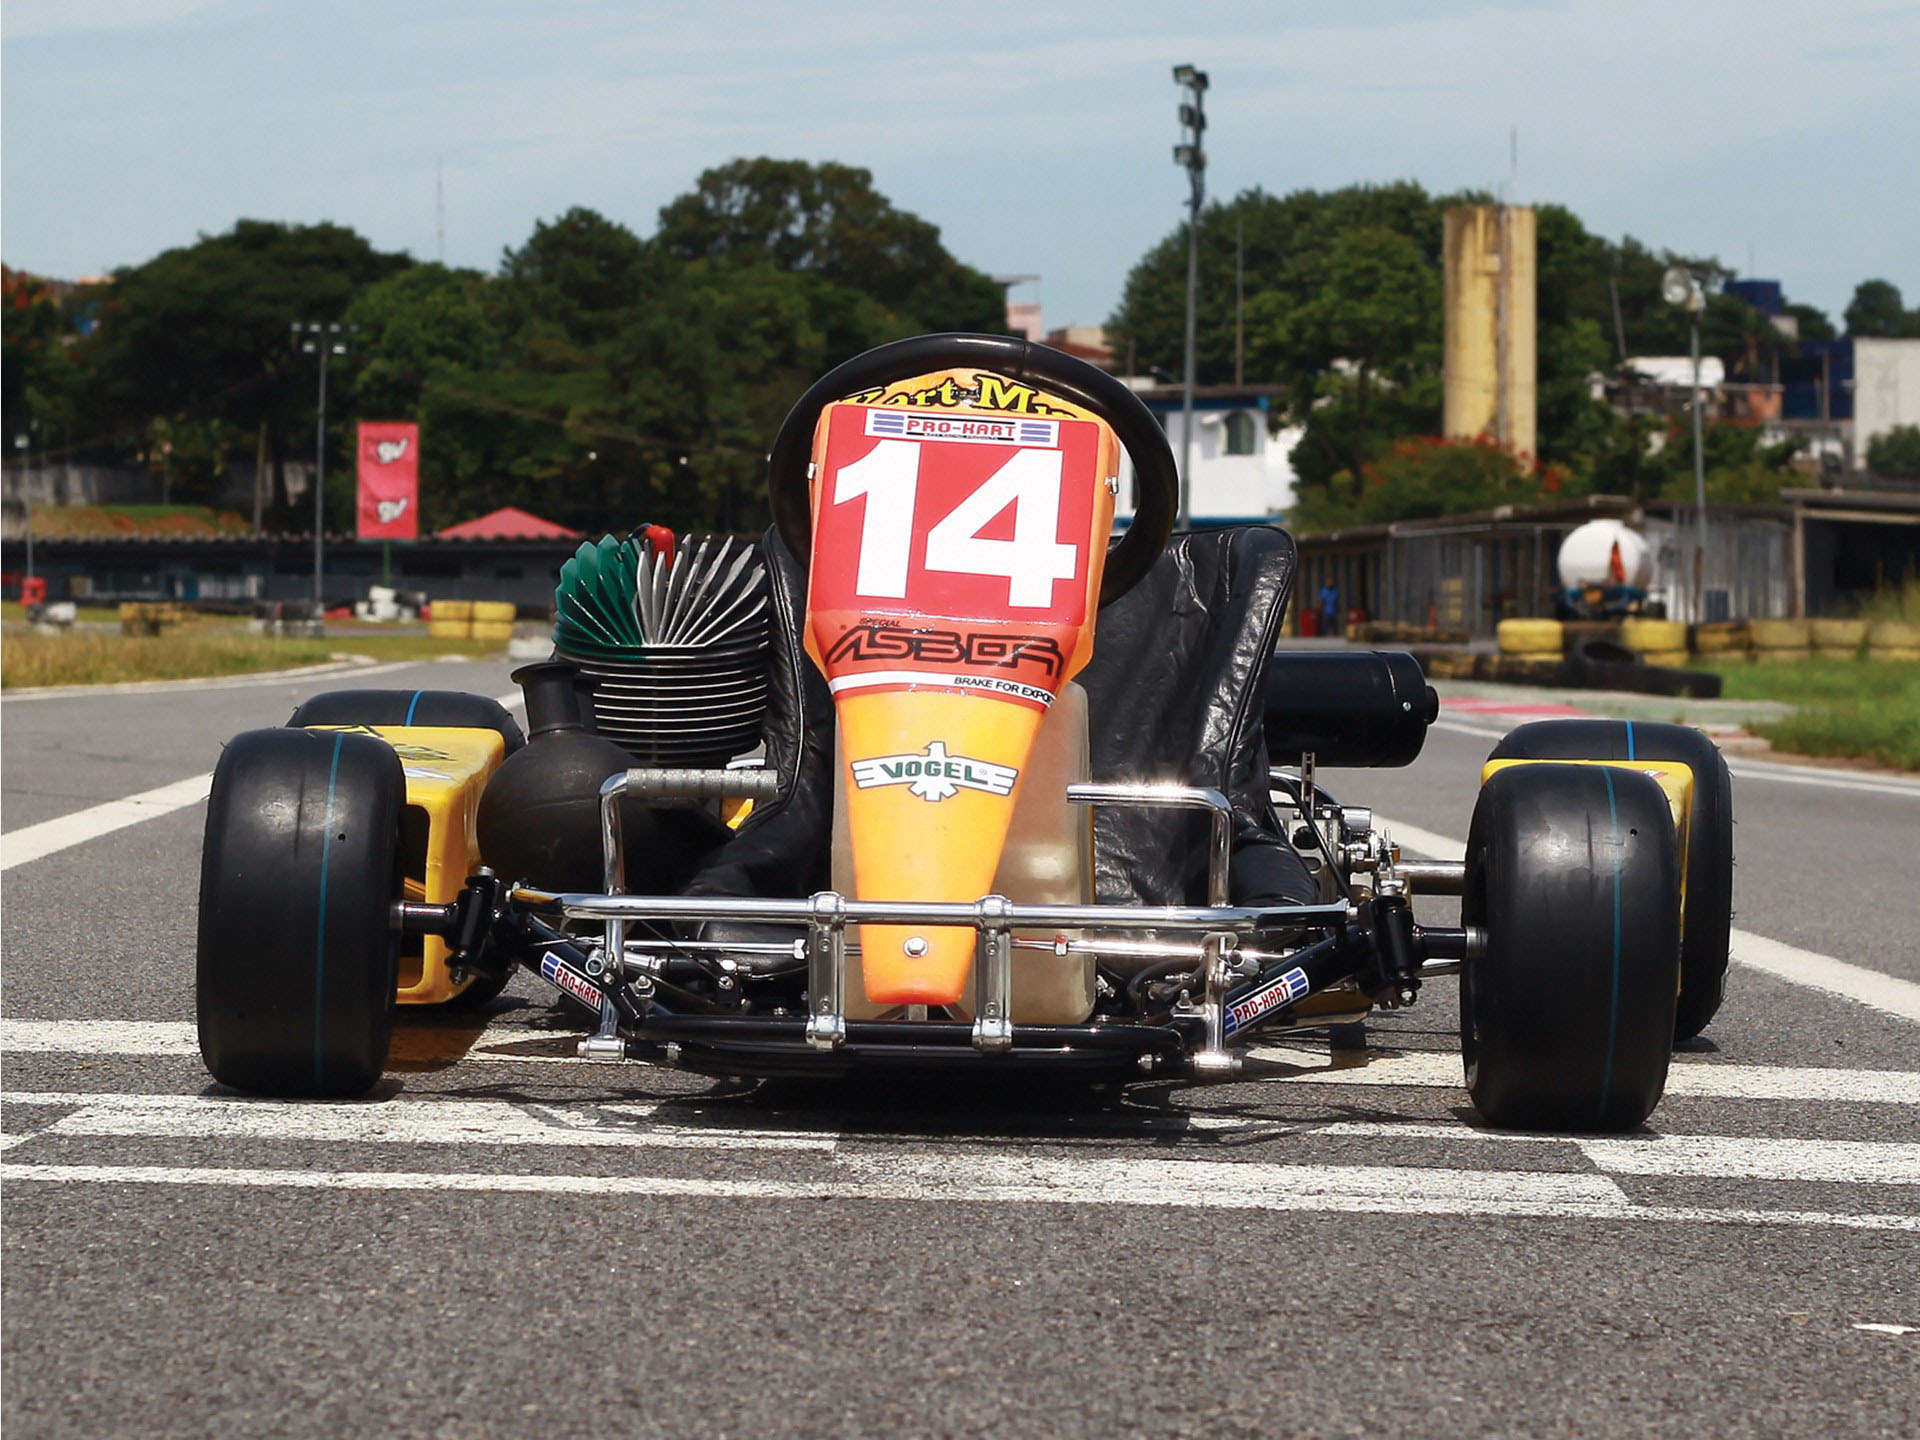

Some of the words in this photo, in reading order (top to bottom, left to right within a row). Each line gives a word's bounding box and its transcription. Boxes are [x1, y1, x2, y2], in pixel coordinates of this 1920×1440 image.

[906, 419, 1017, 437] PRO-KART
[833, 440, 1077, 608] 14
[954, 676, 993, 688] BRAKE
[995, 681, 1020, 693] FOR
[879, 760, 989, 785] VOGEL
[555, 967, 604, 1008] PRO-KART
[1232, 983, 1290, 1023] PRO-KART
